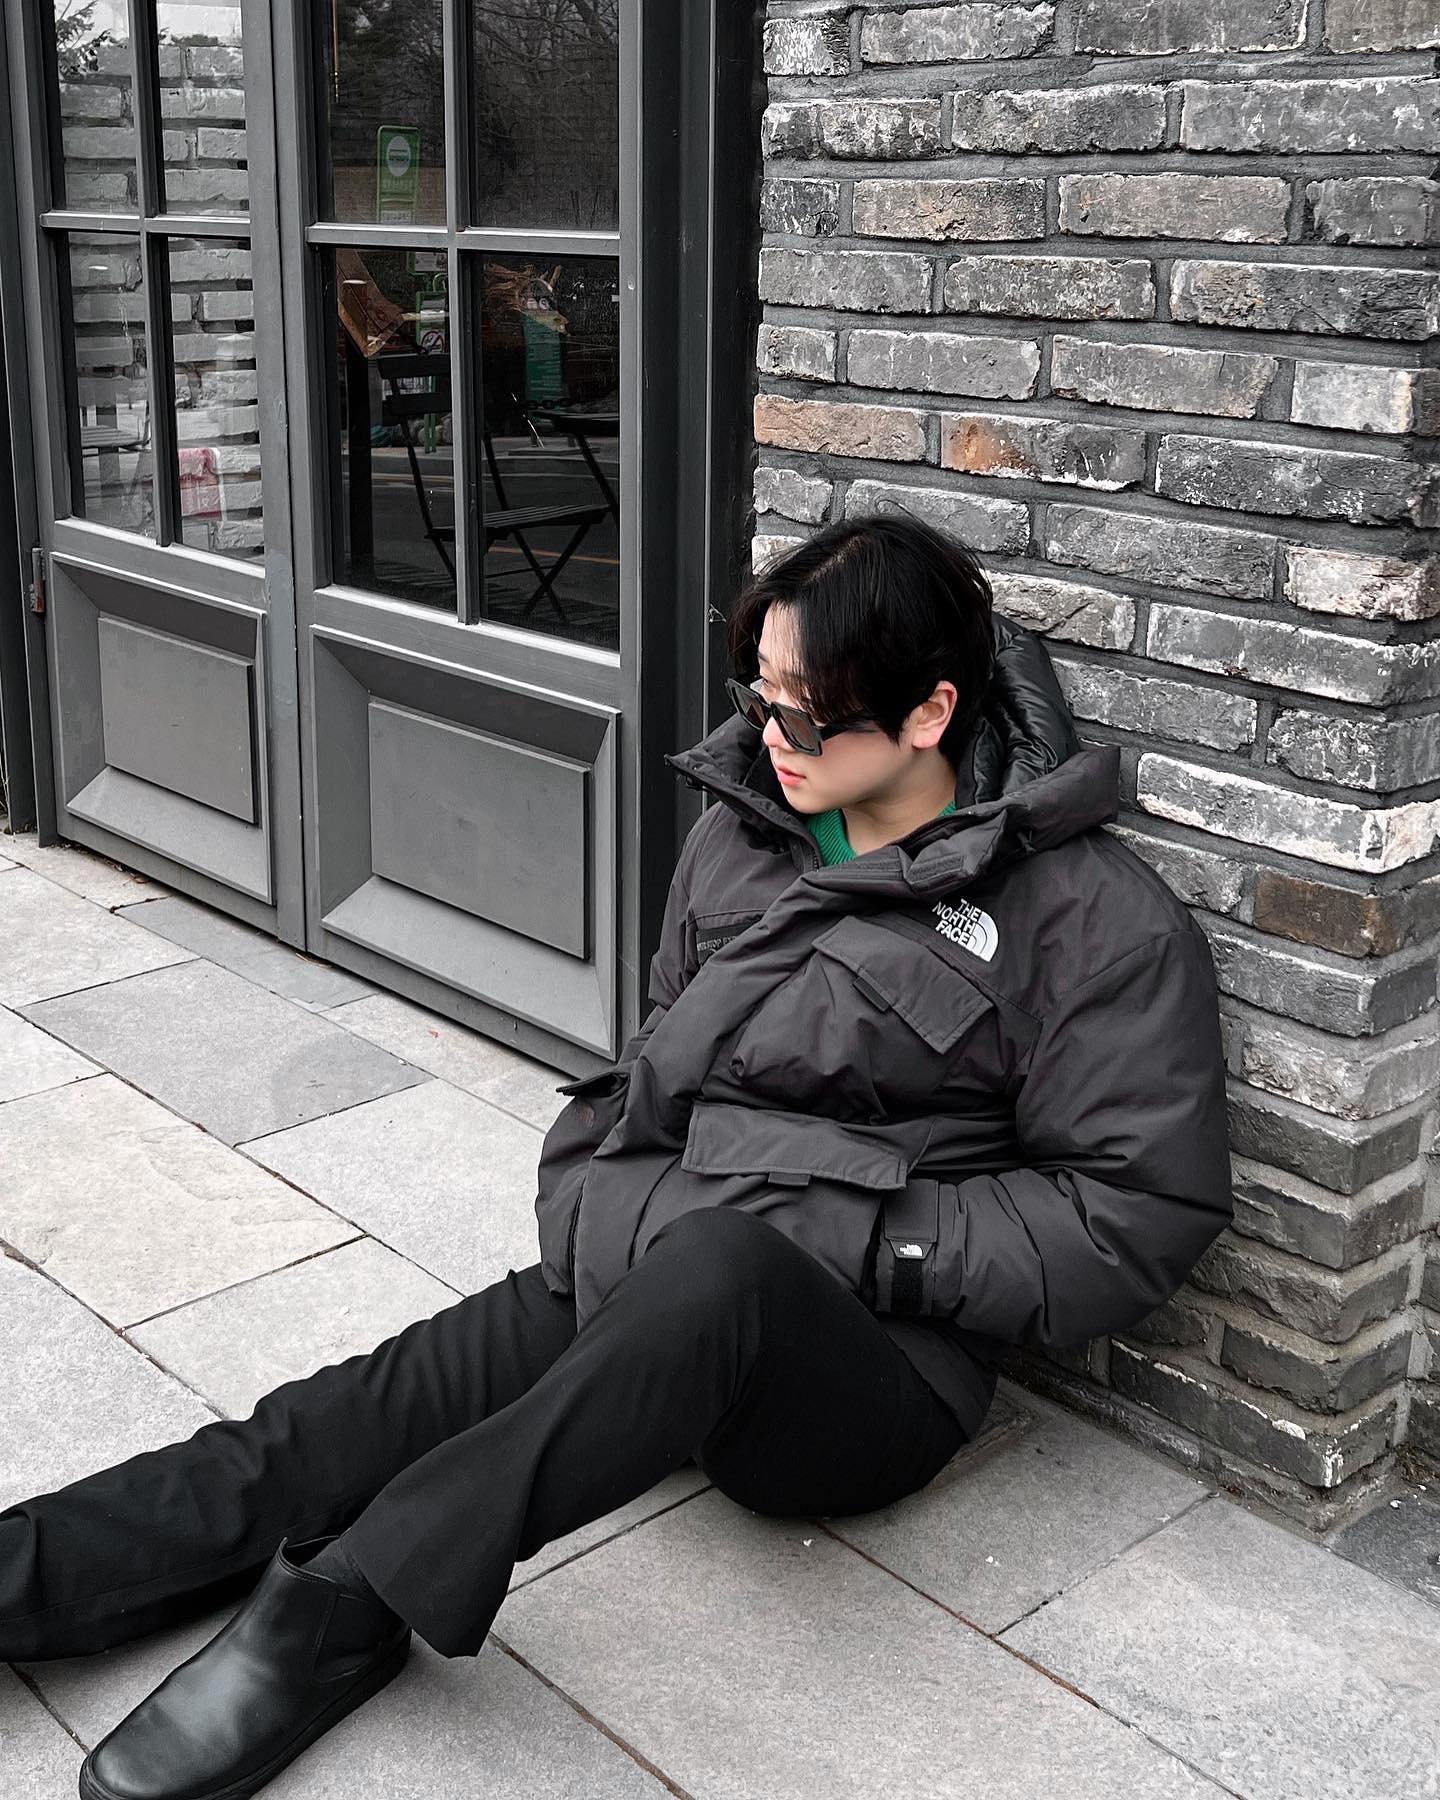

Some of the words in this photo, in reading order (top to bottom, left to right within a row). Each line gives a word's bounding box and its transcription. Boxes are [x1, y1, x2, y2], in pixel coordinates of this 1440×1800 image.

[932, 901, 977, 935] NORTH
[958, 898, 982, 923] THE
[935, 920, 971, 948] FACE
